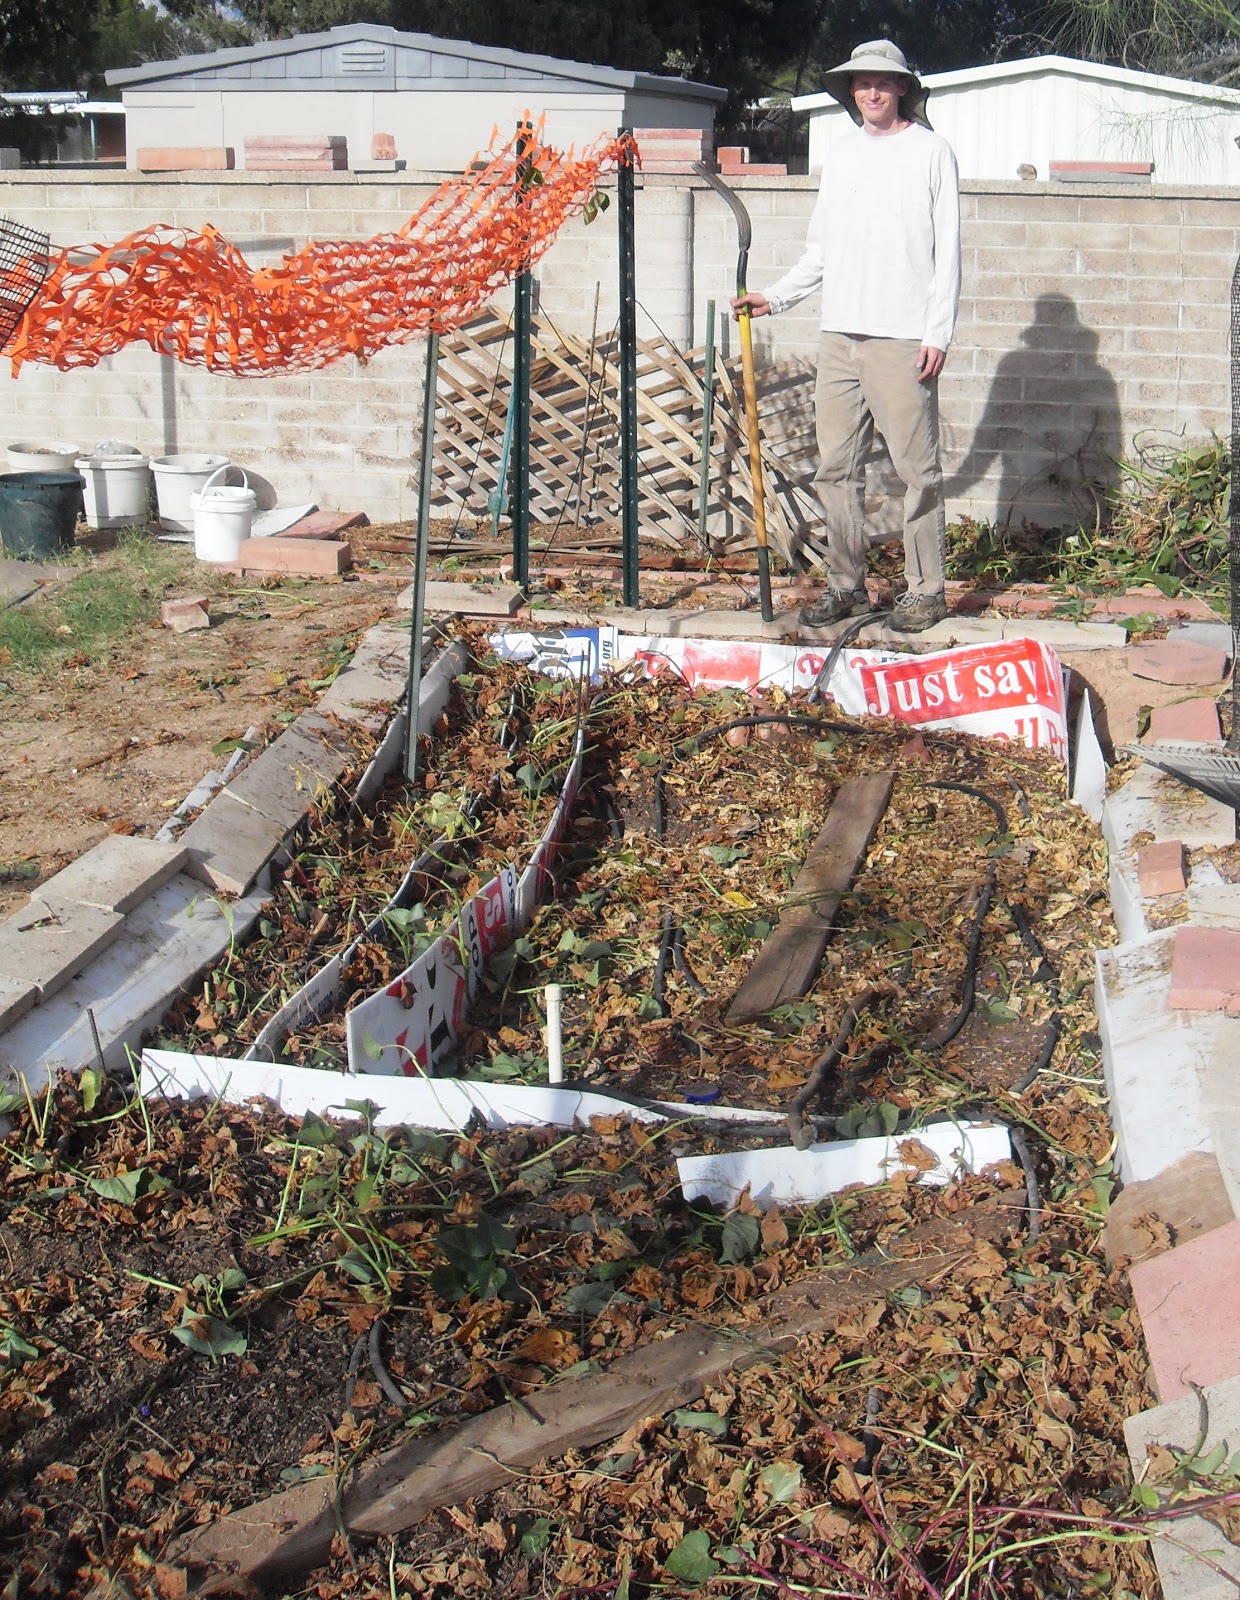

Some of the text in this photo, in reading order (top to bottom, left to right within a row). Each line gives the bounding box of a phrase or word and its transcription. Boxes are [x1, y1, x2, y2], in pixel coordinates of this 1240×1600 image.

[868, 661, 964, 717] Just
[973, 659, 1038, 704] say
[993, 717, 1039, 749] ll
